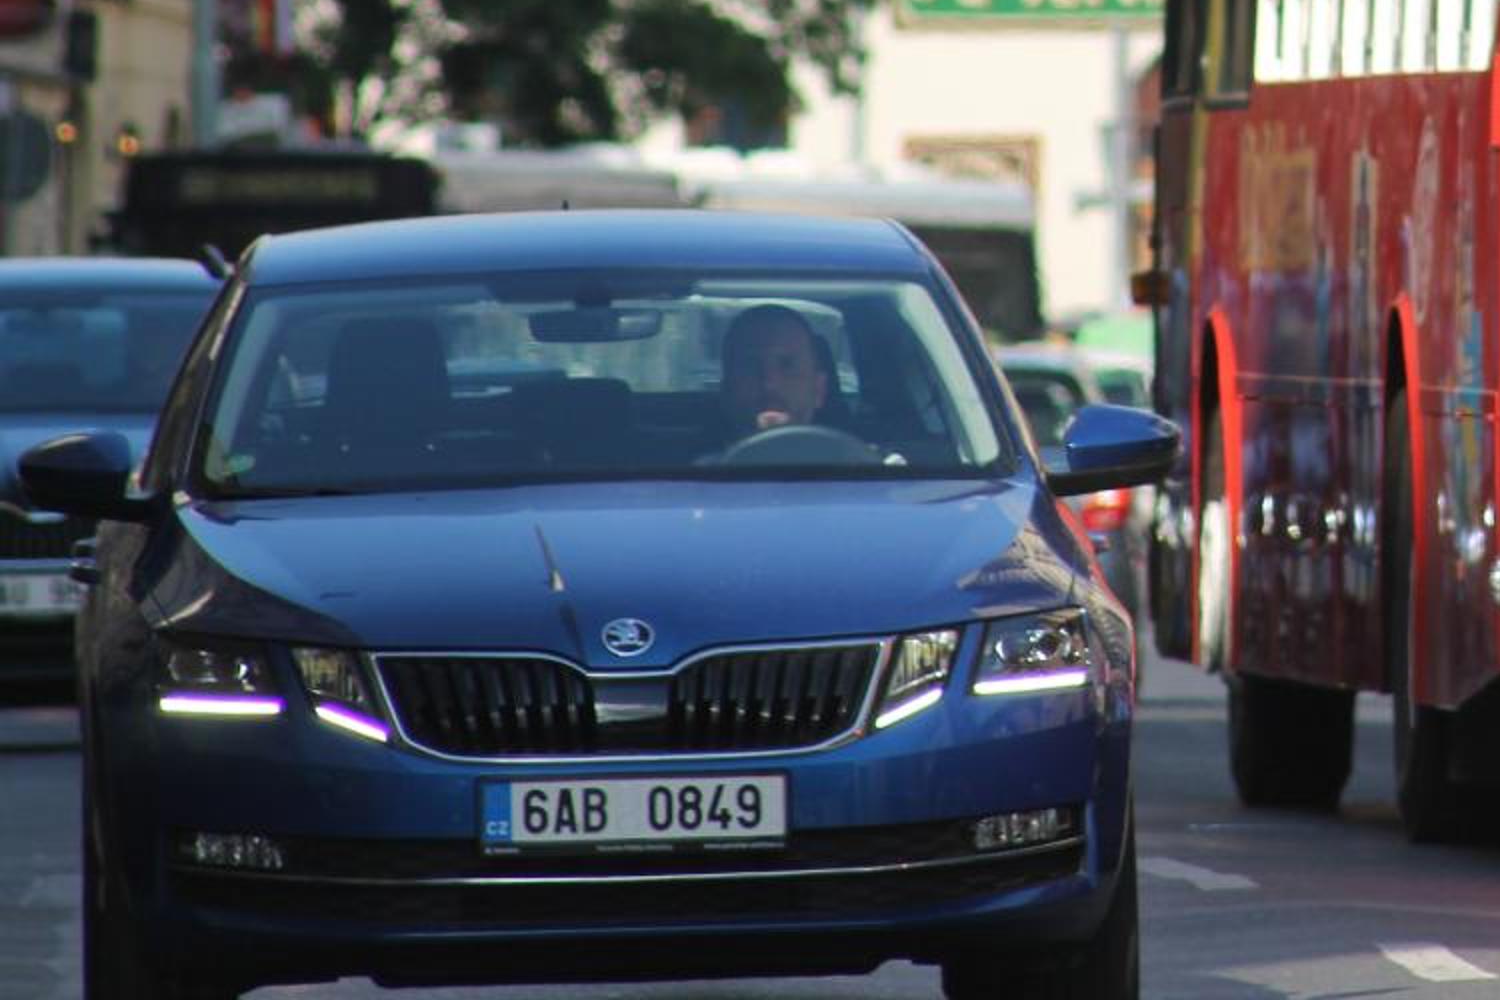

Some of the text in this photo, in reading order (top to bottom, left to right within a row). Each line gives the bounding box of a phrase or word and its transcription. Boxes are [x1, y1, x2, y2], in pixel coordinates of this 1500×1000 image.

[485, 784, 762, 836] CZ 6AB 0849
